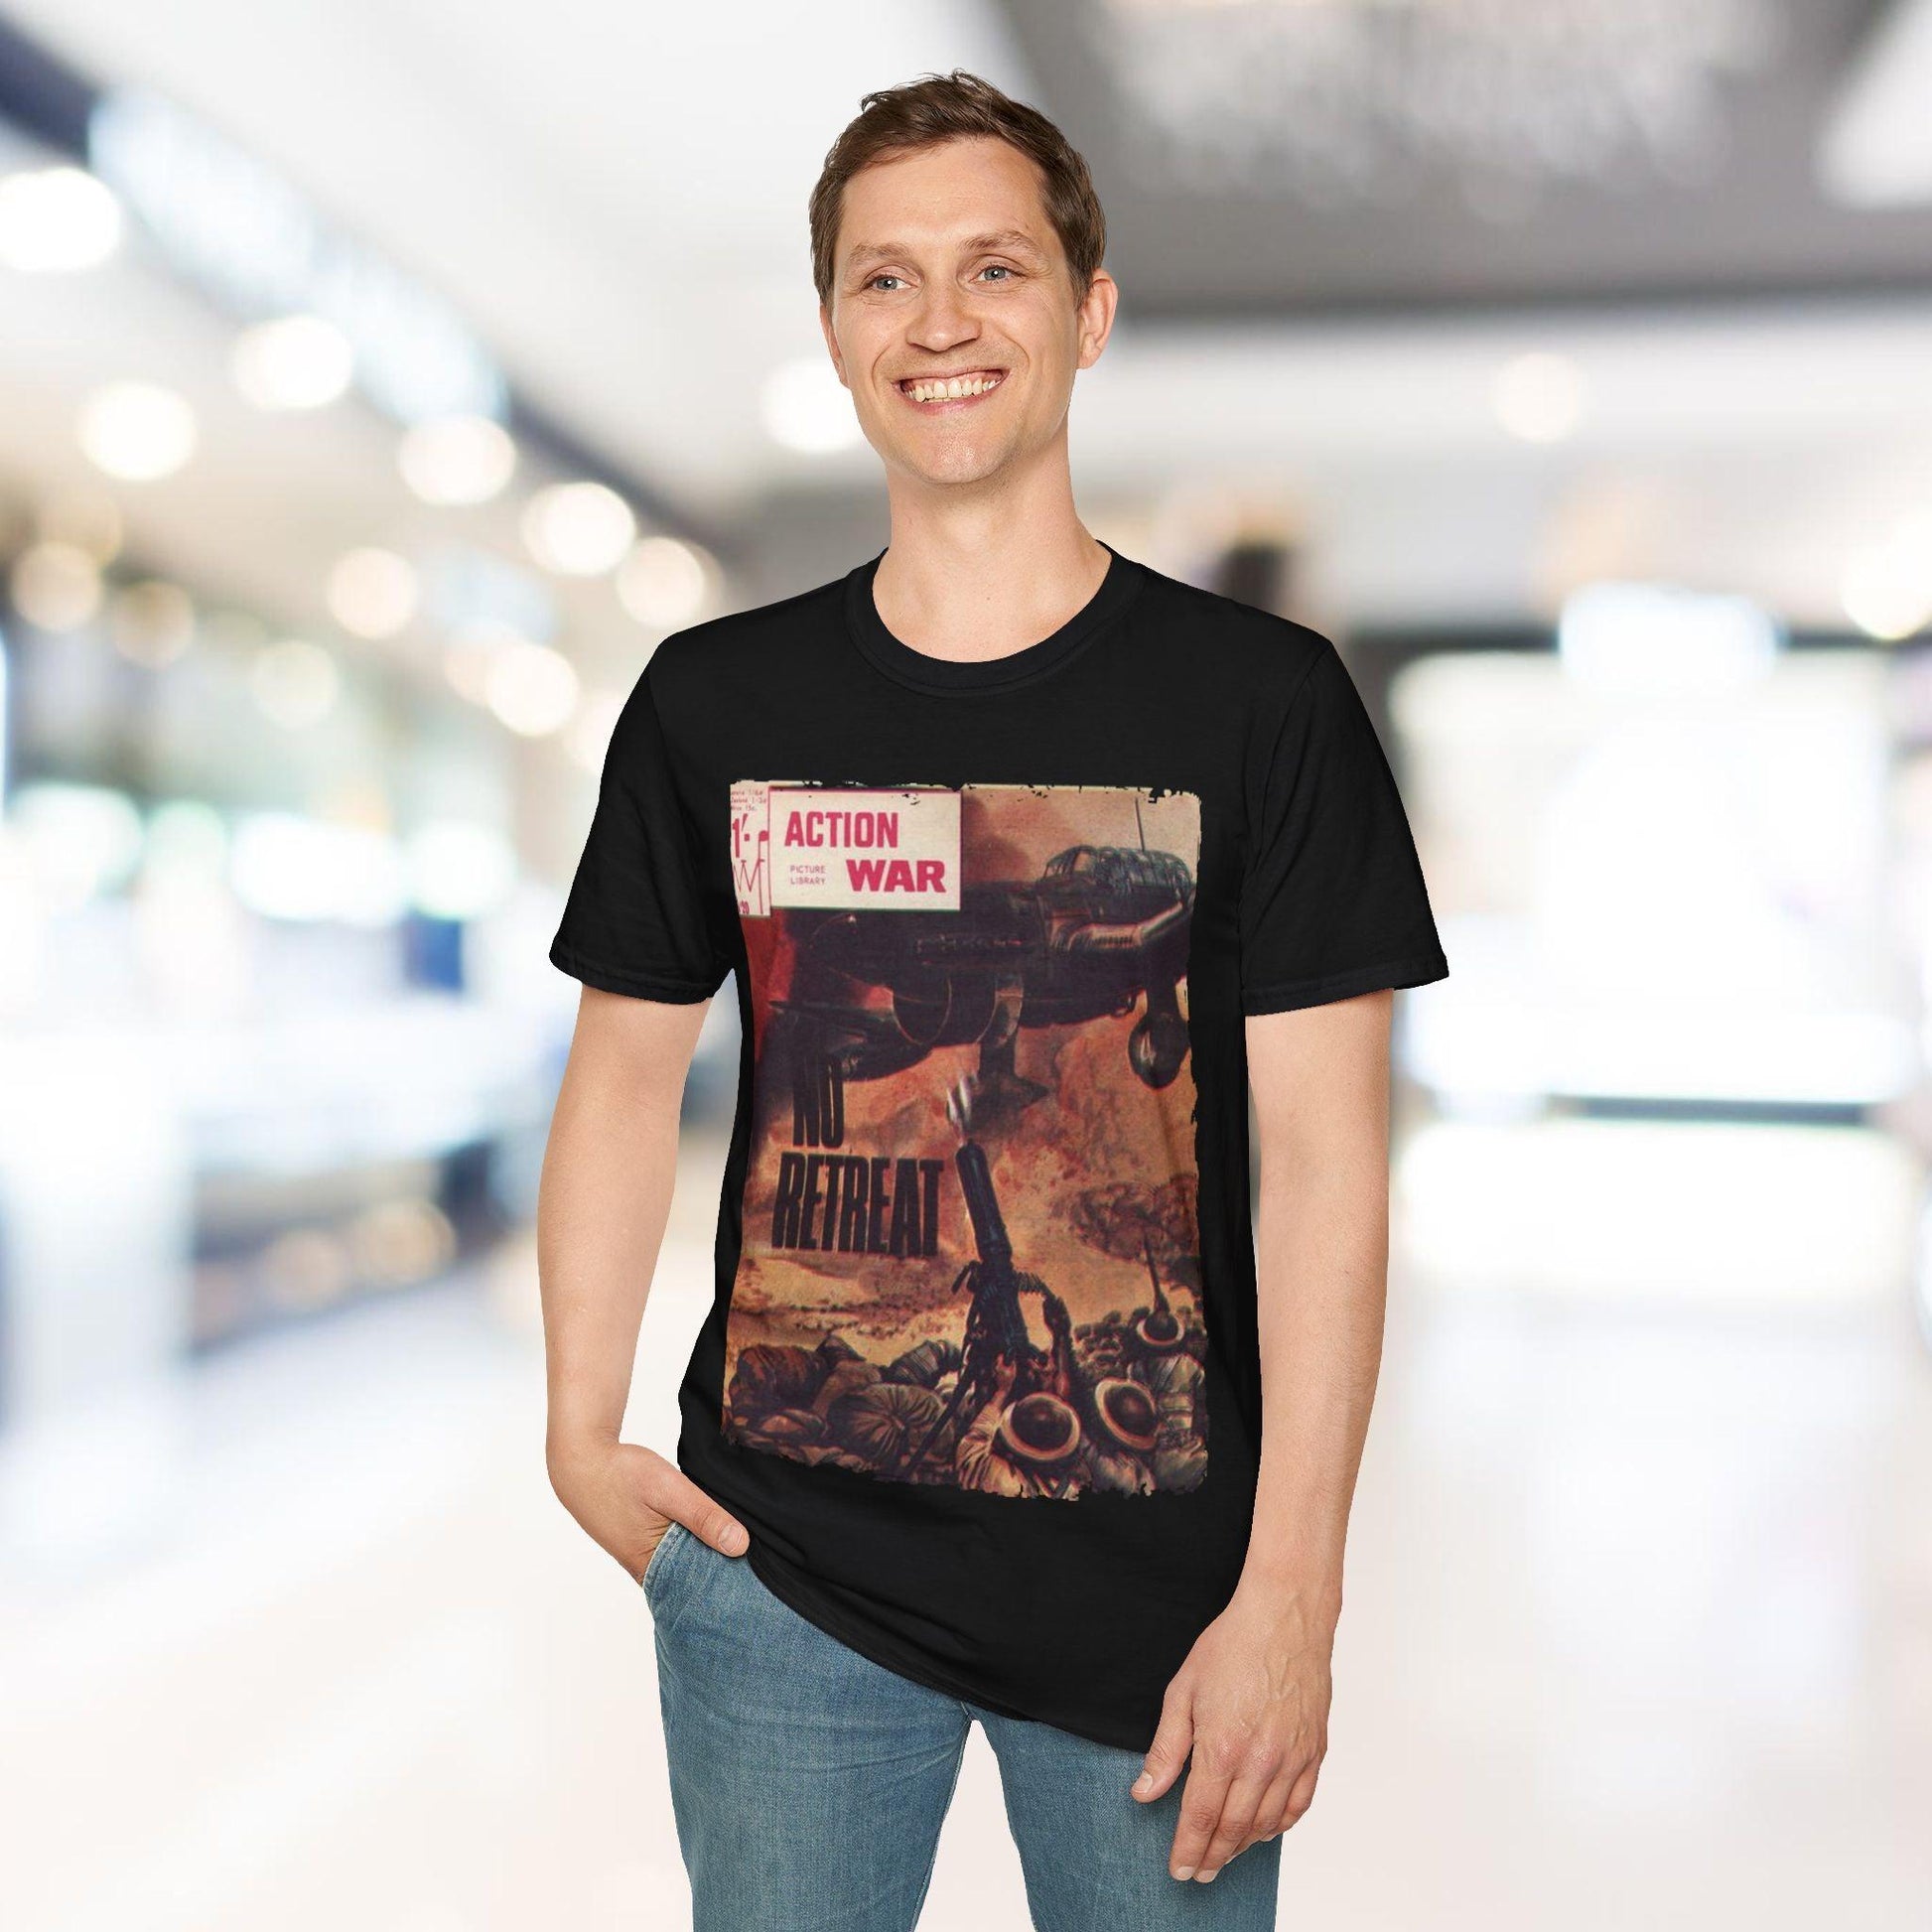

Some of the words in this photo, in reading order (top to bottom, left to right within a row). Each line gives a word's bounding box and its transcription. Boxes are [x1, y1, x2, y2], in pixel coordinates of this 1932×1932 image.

[784, 810, 898, 848] ACTION
[789, 864, 826, 874] PICTURE
[789, 876, 826, 886] LIBRARY
[846, 859, 947, 893] WAR
[792, 1050, 845, 1149] NO
[771, 1152, 944, 1257] RETREAT
